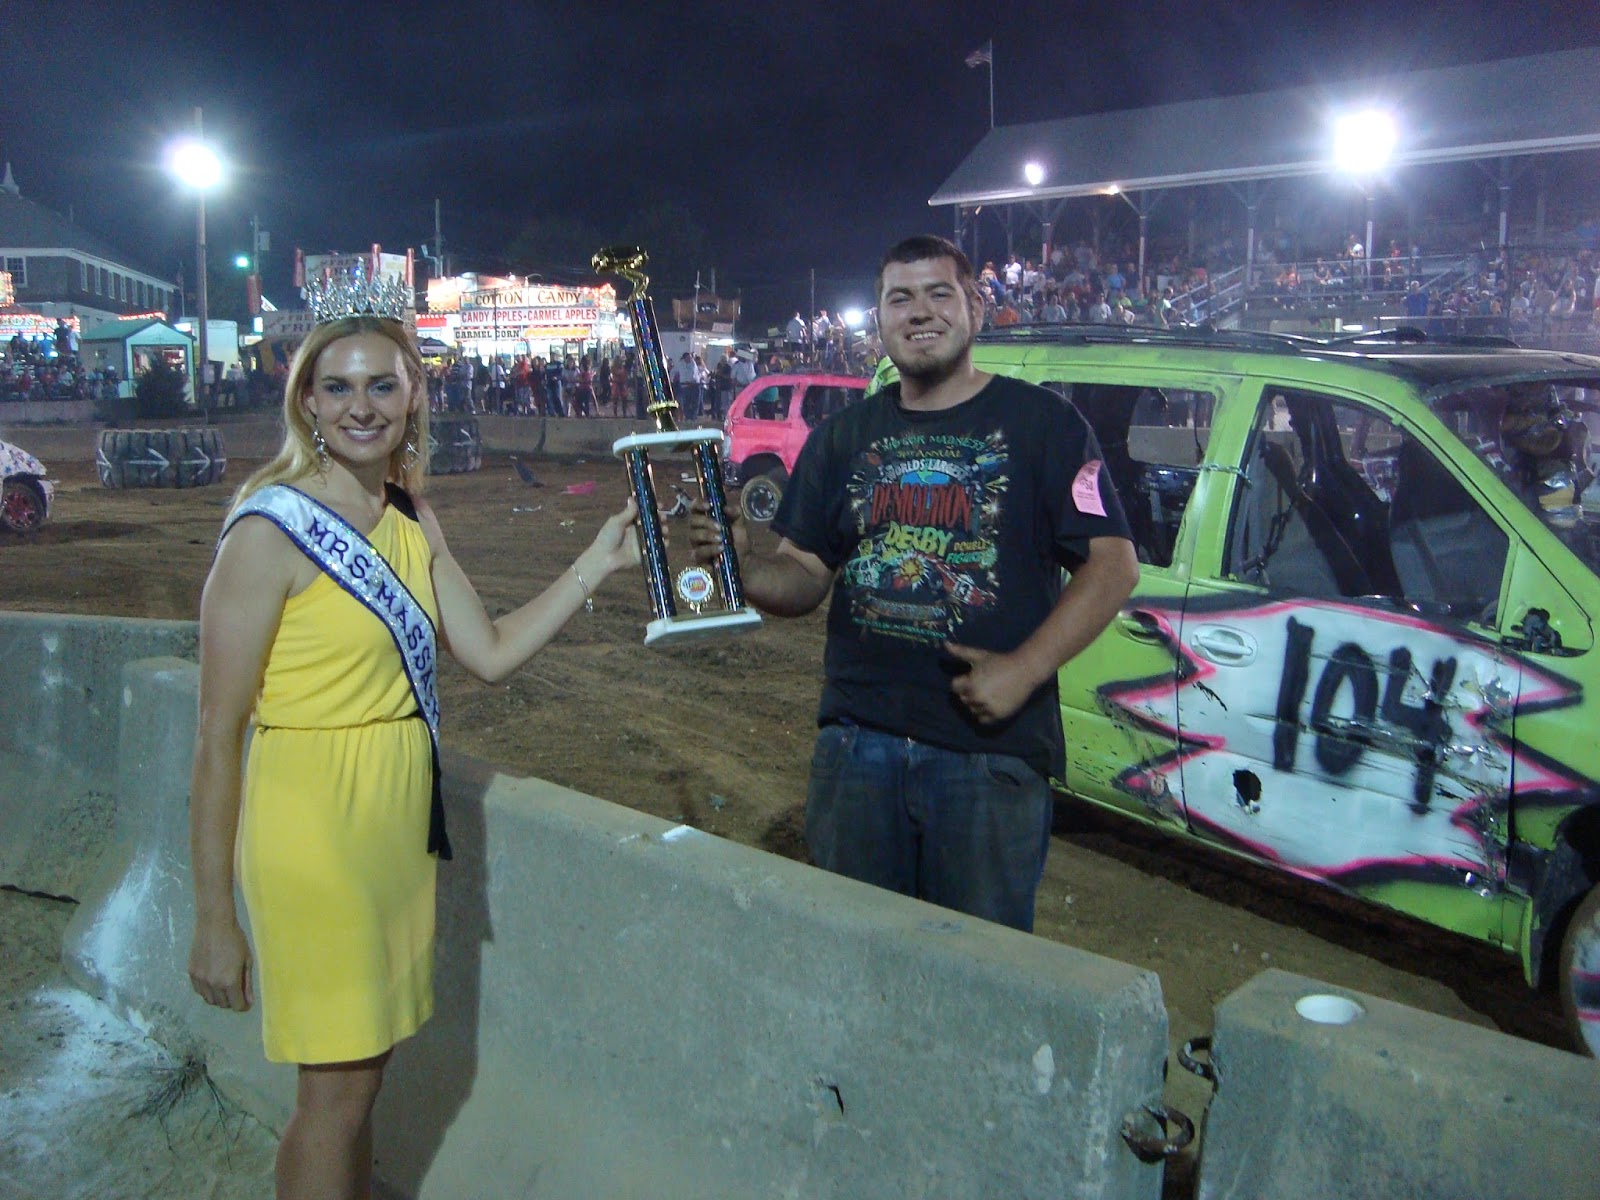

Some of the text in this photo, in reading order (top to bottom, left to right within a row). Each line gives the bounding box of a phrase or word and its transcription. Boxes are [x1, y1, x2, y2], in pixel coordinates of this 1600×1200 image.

[461, 311, 489, 323] CANDY
[491, 310, 523, 322] APPLES
[527, 309, 563, 321] CARMEL
[565, 308, 598, 320] APPLES
[475, 289, 582, 306] COTTON CANDY
[455, 329, 521, 339] CARMEL CORN
[869, 482, 975, 532] DEMOLITION
[306, 515, 373, 587] MRS.
[884, 520, 955, 558] DERBY
[1272, 615, 1457, 817] 104
